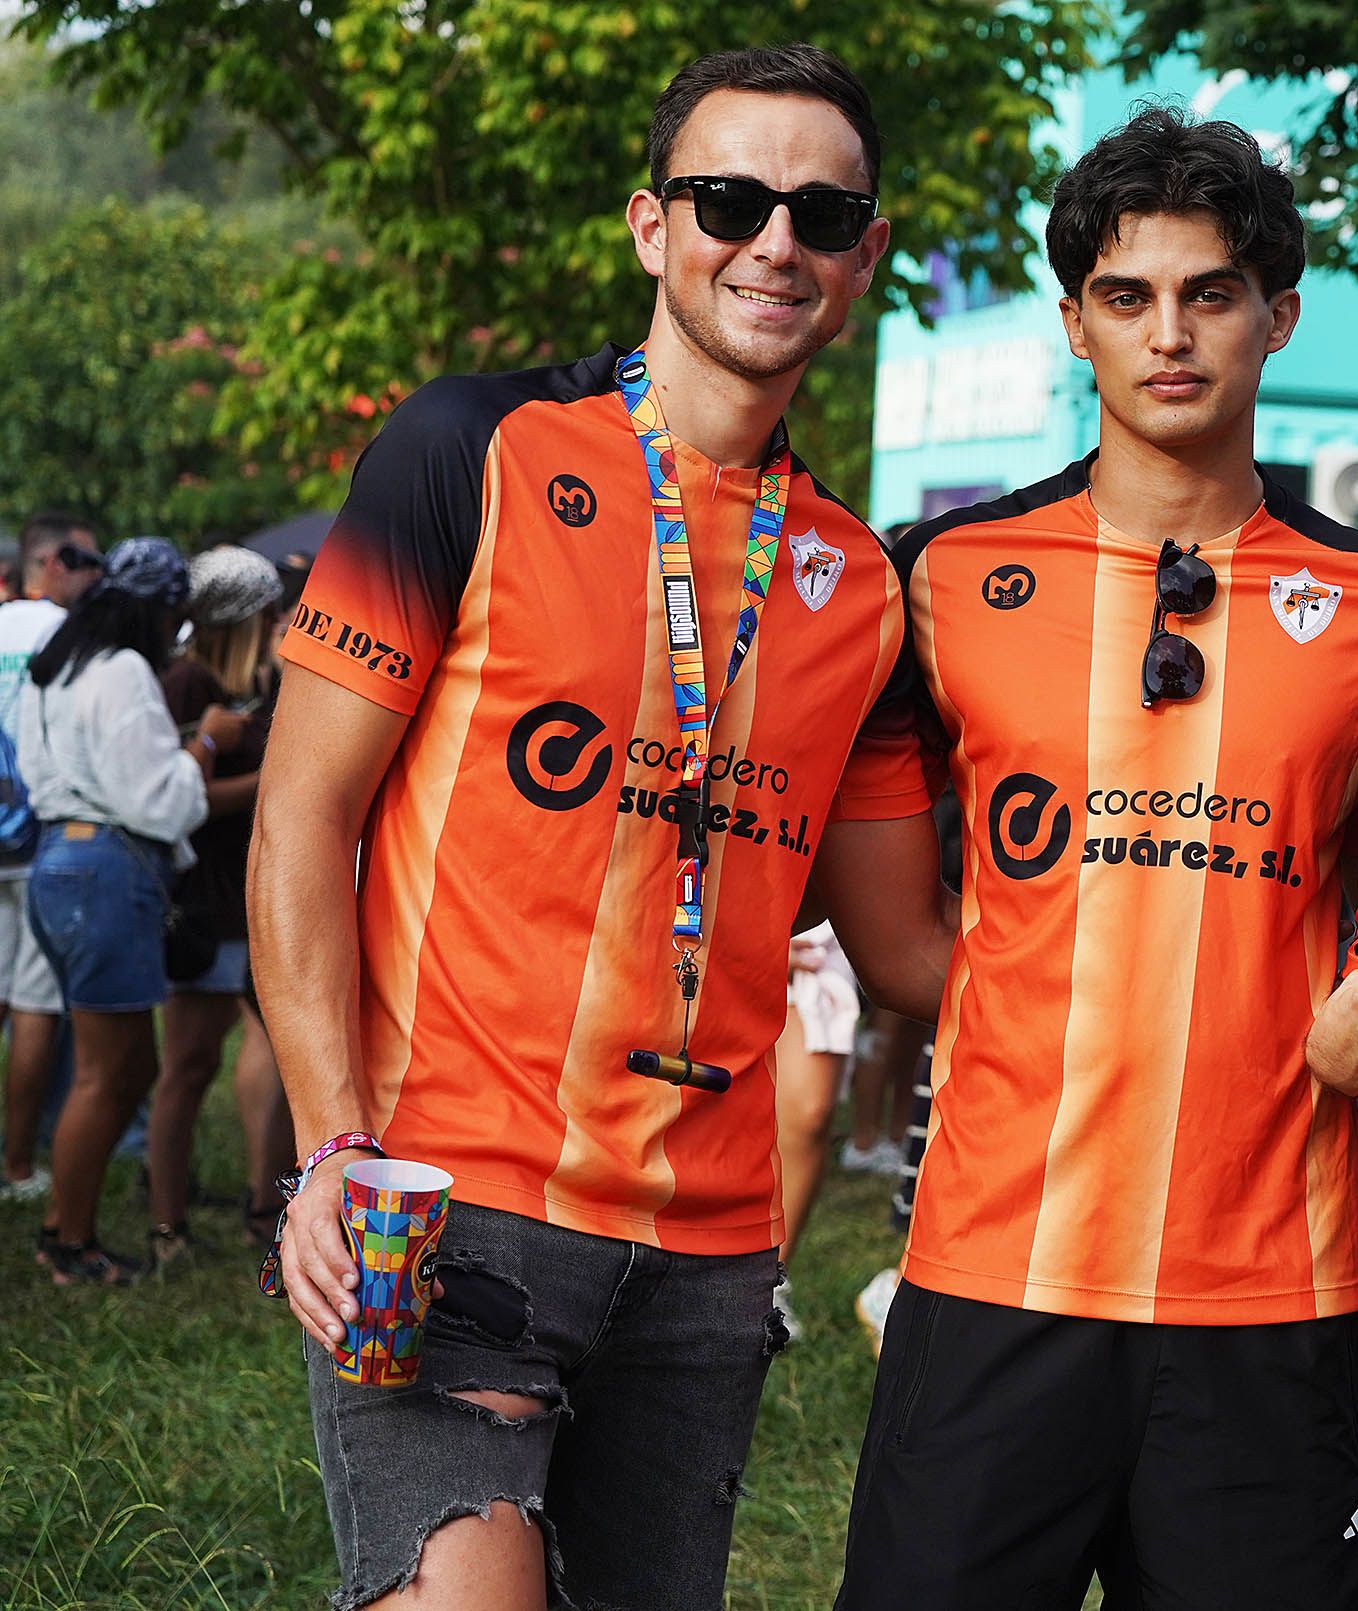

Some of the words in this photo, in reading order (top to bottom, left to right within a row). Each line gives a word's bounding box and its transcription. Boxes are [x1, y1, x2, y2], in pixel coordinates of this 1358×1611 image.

[1001, 592, 1015, 603] 18
[292, 603, 333, 641] DE
[332, 621, 413, 679] 1973
[626, 737, 789, 794] cocdero
[617, 785, 770, 845] suáez,
[777, 815, 811, 857] s.l.
[1085, 782, 1271, 827] cocedero
[1081, 829, 1249, 879] suárez,
[1259, 845, 1302, 888] s.l.
